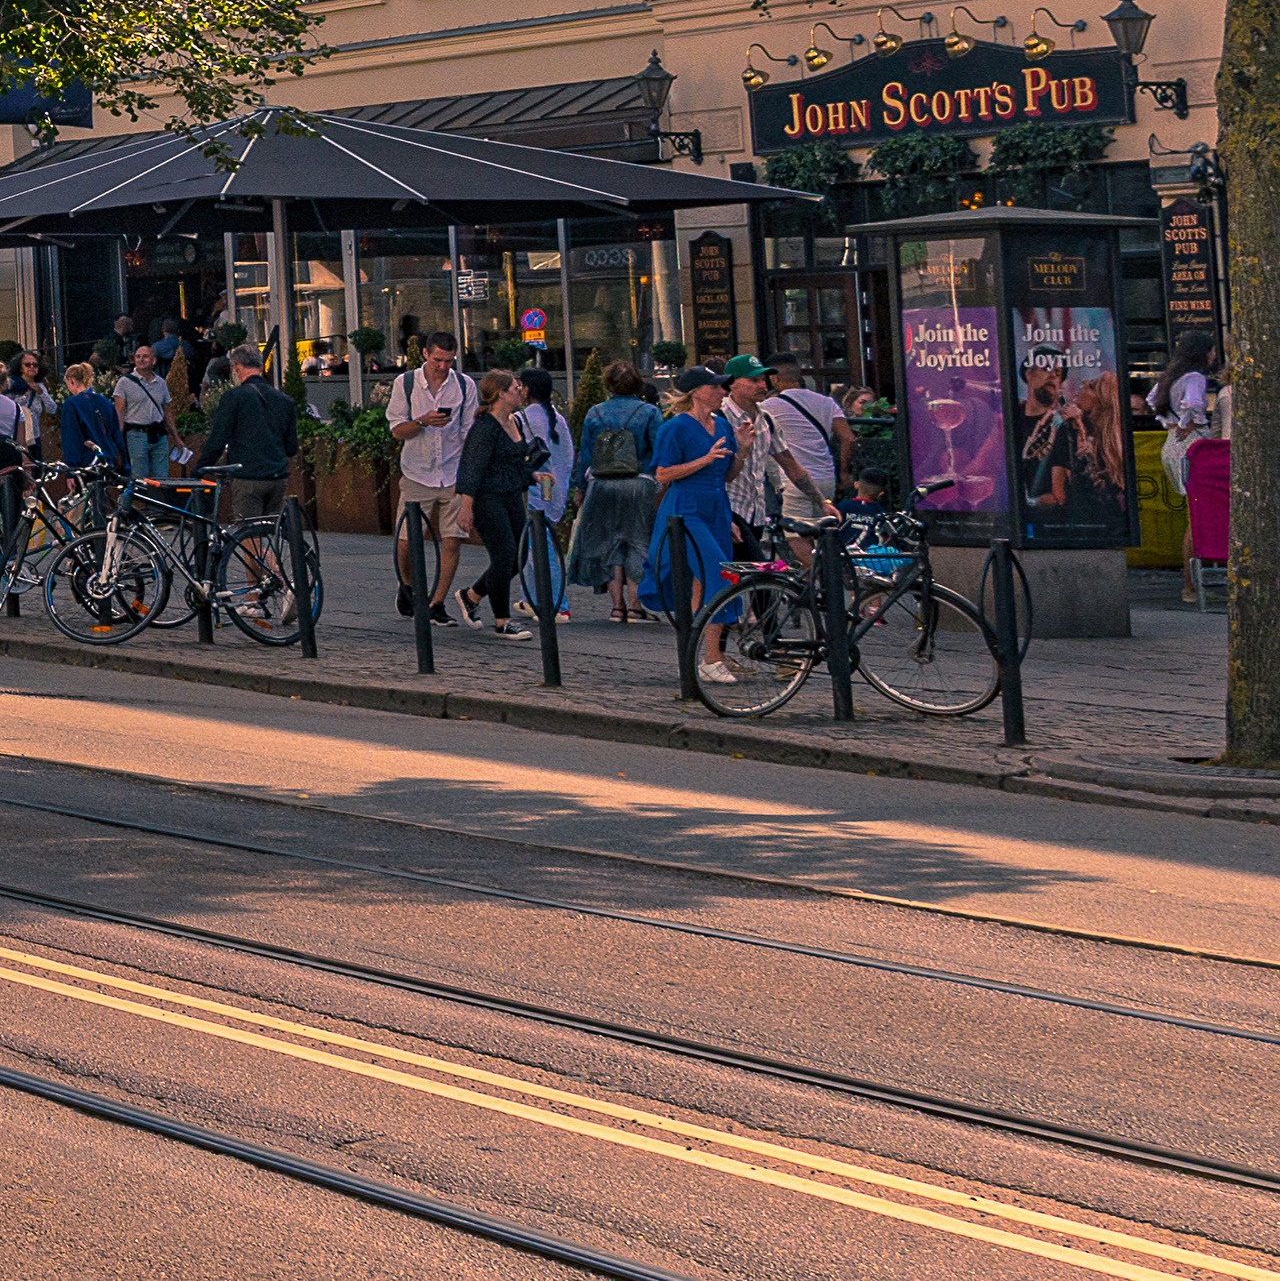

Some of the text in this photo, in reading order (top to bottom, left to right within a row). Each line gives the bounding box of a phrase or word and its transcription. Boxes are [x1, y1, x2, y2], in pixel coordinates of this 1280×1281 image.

[784, 67, 1097, 137] JOHN SCOTT'S PUB
[1170, 214, 1198, 227] JOHN
[1175, 242, 1199, 255] PUB
[1033, 264, 1077, 273] MELODY
[1043, 276, 1072, 285] CLUB
[1169, 300, 1212, 311] FINE WINE
[914, 323, 989, 342] Join the
[1022, 323, 1100, 342] Join the
[916, 348, 990, 371] Joyride!
[1023, 349, 1101, 371] Joyride!
